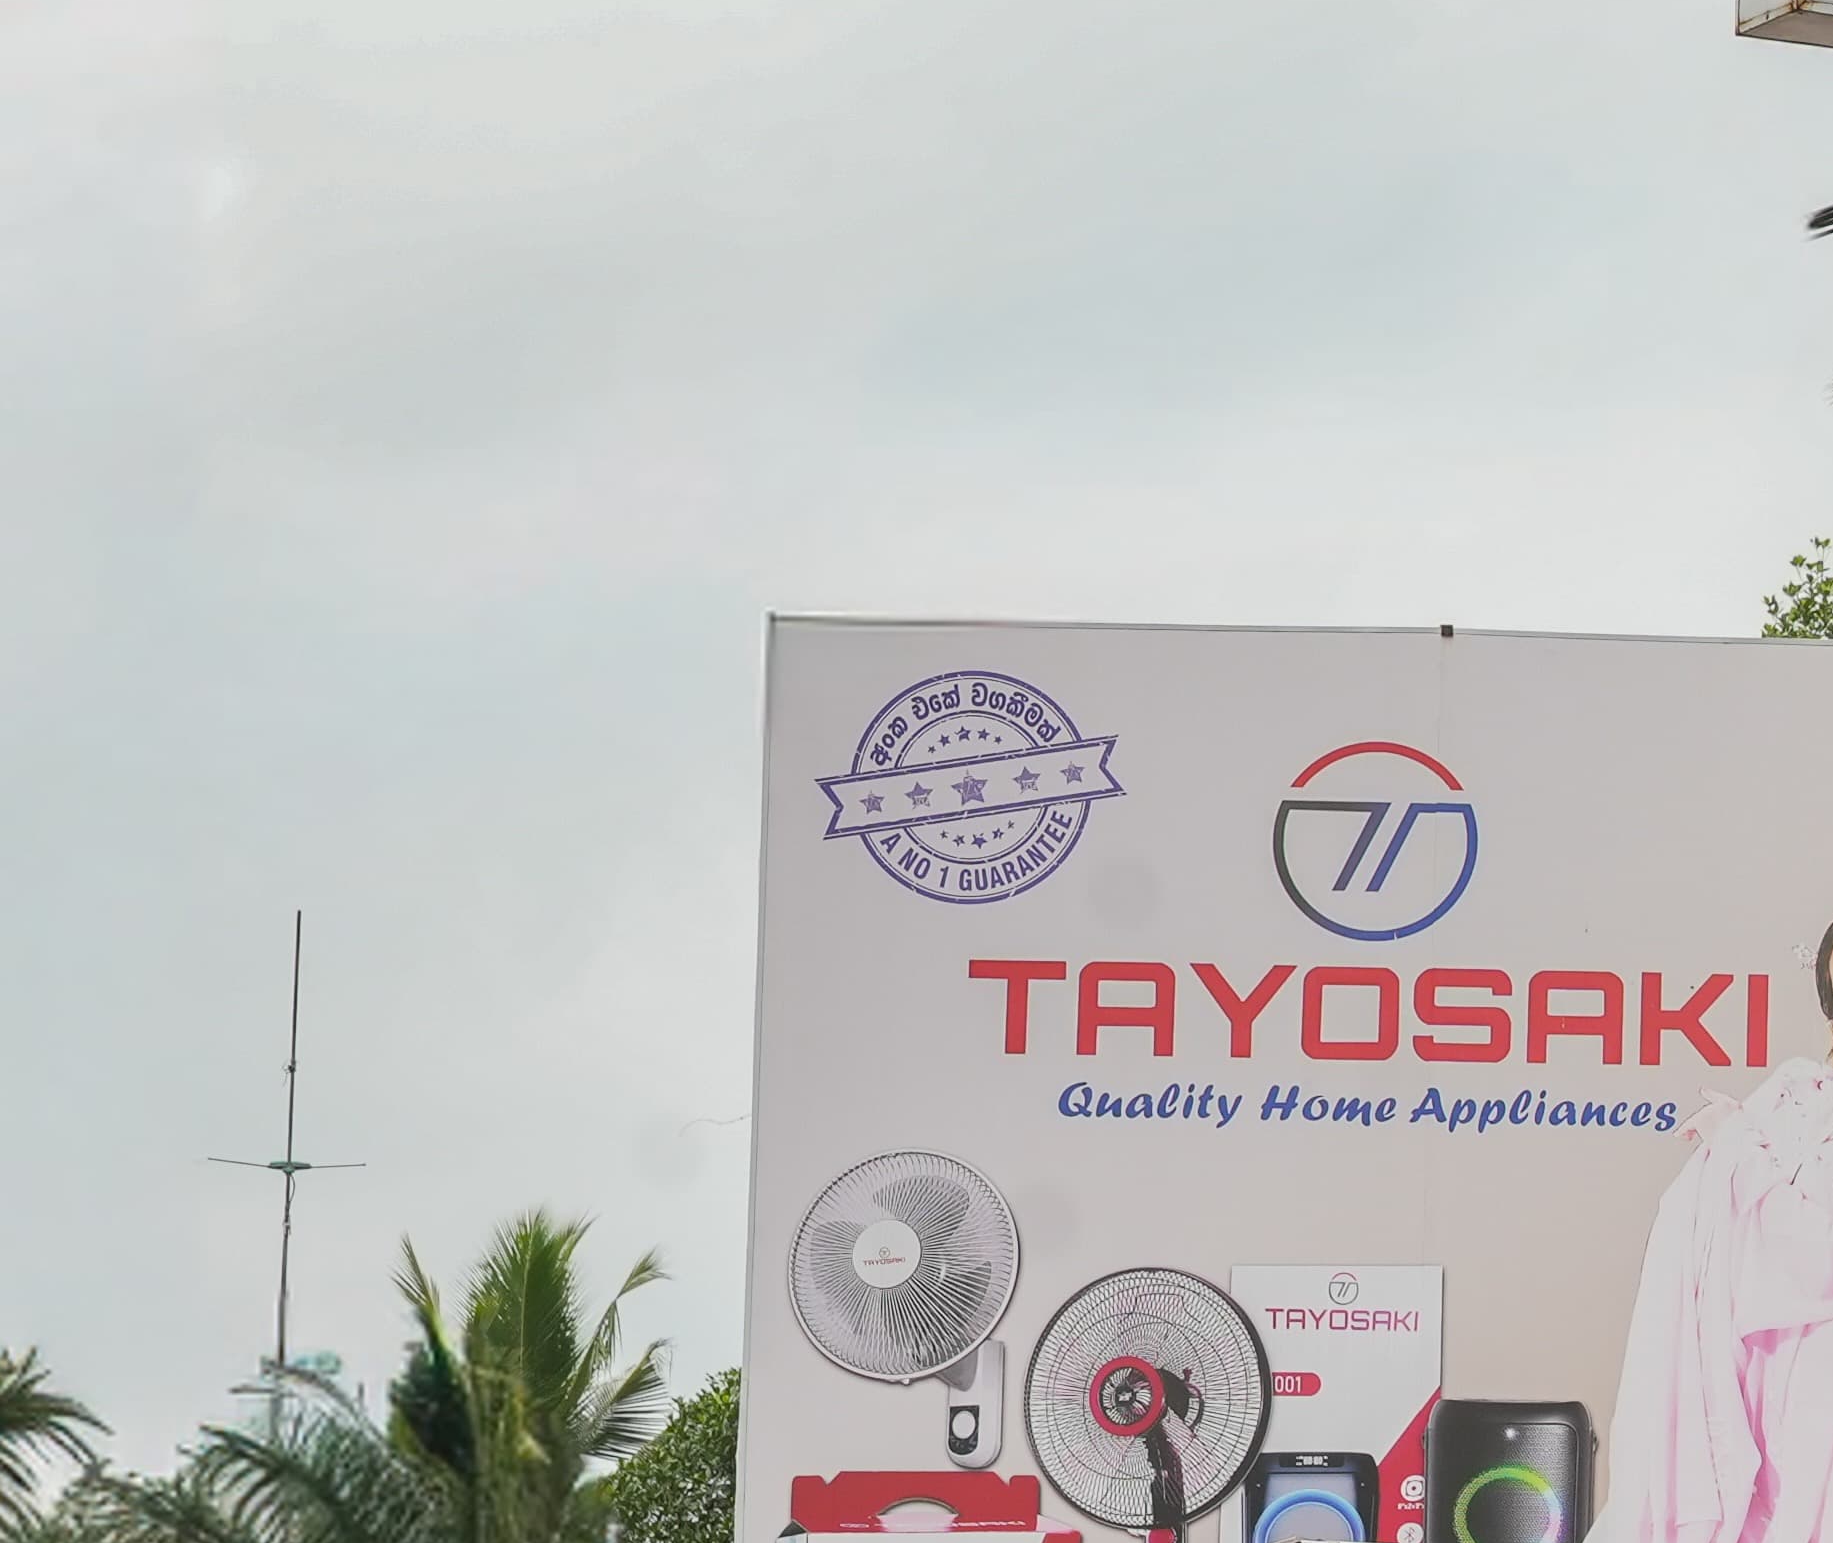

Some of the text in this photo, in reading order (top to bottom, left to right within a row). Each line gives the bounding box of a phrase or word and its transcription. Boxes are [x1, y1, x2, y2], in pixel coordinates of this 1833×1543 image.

[870, 716, 909, 766] අංක
[880, 810, 1073, 891] A NO 1 GUARANTEE
[969, 960, 1769, 1069] TAYOSAKI
[1058, 1081, 1678, 1133] Quality Home Appliances
[1265, 1307, 1420, 1332] TAYOSAKI
